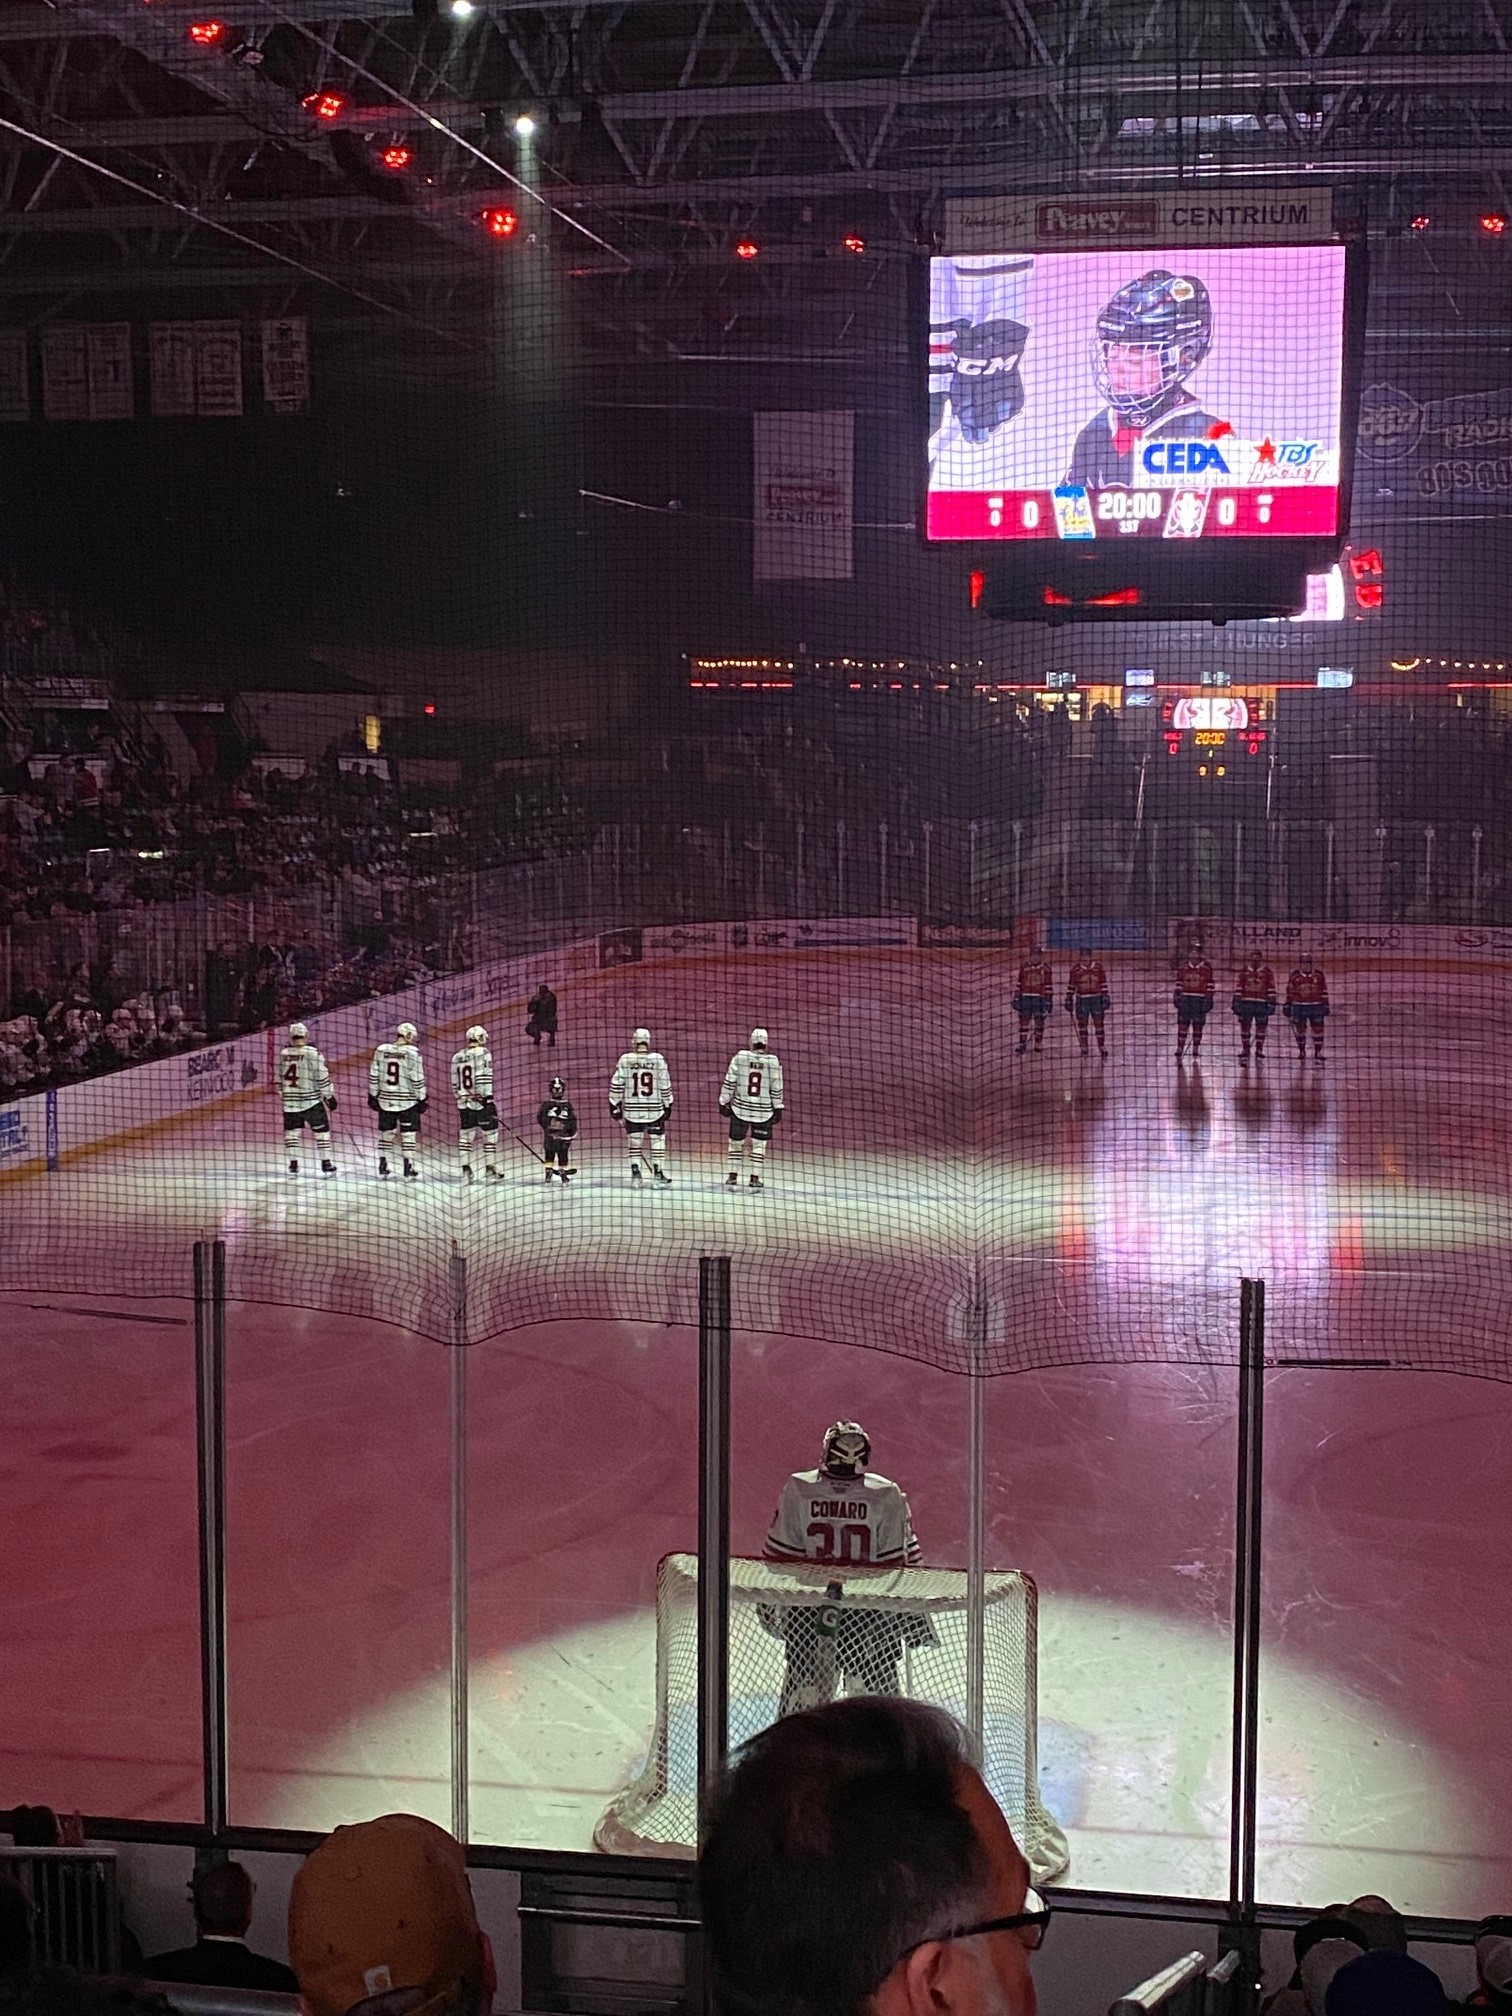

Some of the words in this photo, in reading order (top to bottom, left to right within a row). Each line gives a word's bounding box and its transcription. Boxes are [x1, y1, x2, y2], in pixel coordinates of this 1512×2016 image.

[1045, 206, 1126, 233] Peavey
[1171, 204, 1308, 228] CENTRIUM
[1143, 443, 1231, 474] CEDA
[1278, 443, 1318, 465] TBS
[1247, 461, 1325, 484] HOCKEY
[1023, 500, 1038, 528] 0
[1098, 492, 1161, 519] 20:00
[1219, 498, 1235, 525] 0
[1119, 519, 1139, 533] 1ST
[1194, 732, 1225, 745] 20:00
[284, 1063, 299, 1087] 4
[387, 1061, 400, 1086] 9
[456, 1065, 473, 1090] 18
[631, 1071, 654, 1097] 19
[747, 1071, 762, 1097] 8
[810, 1500, 868, 1519] COWARD
